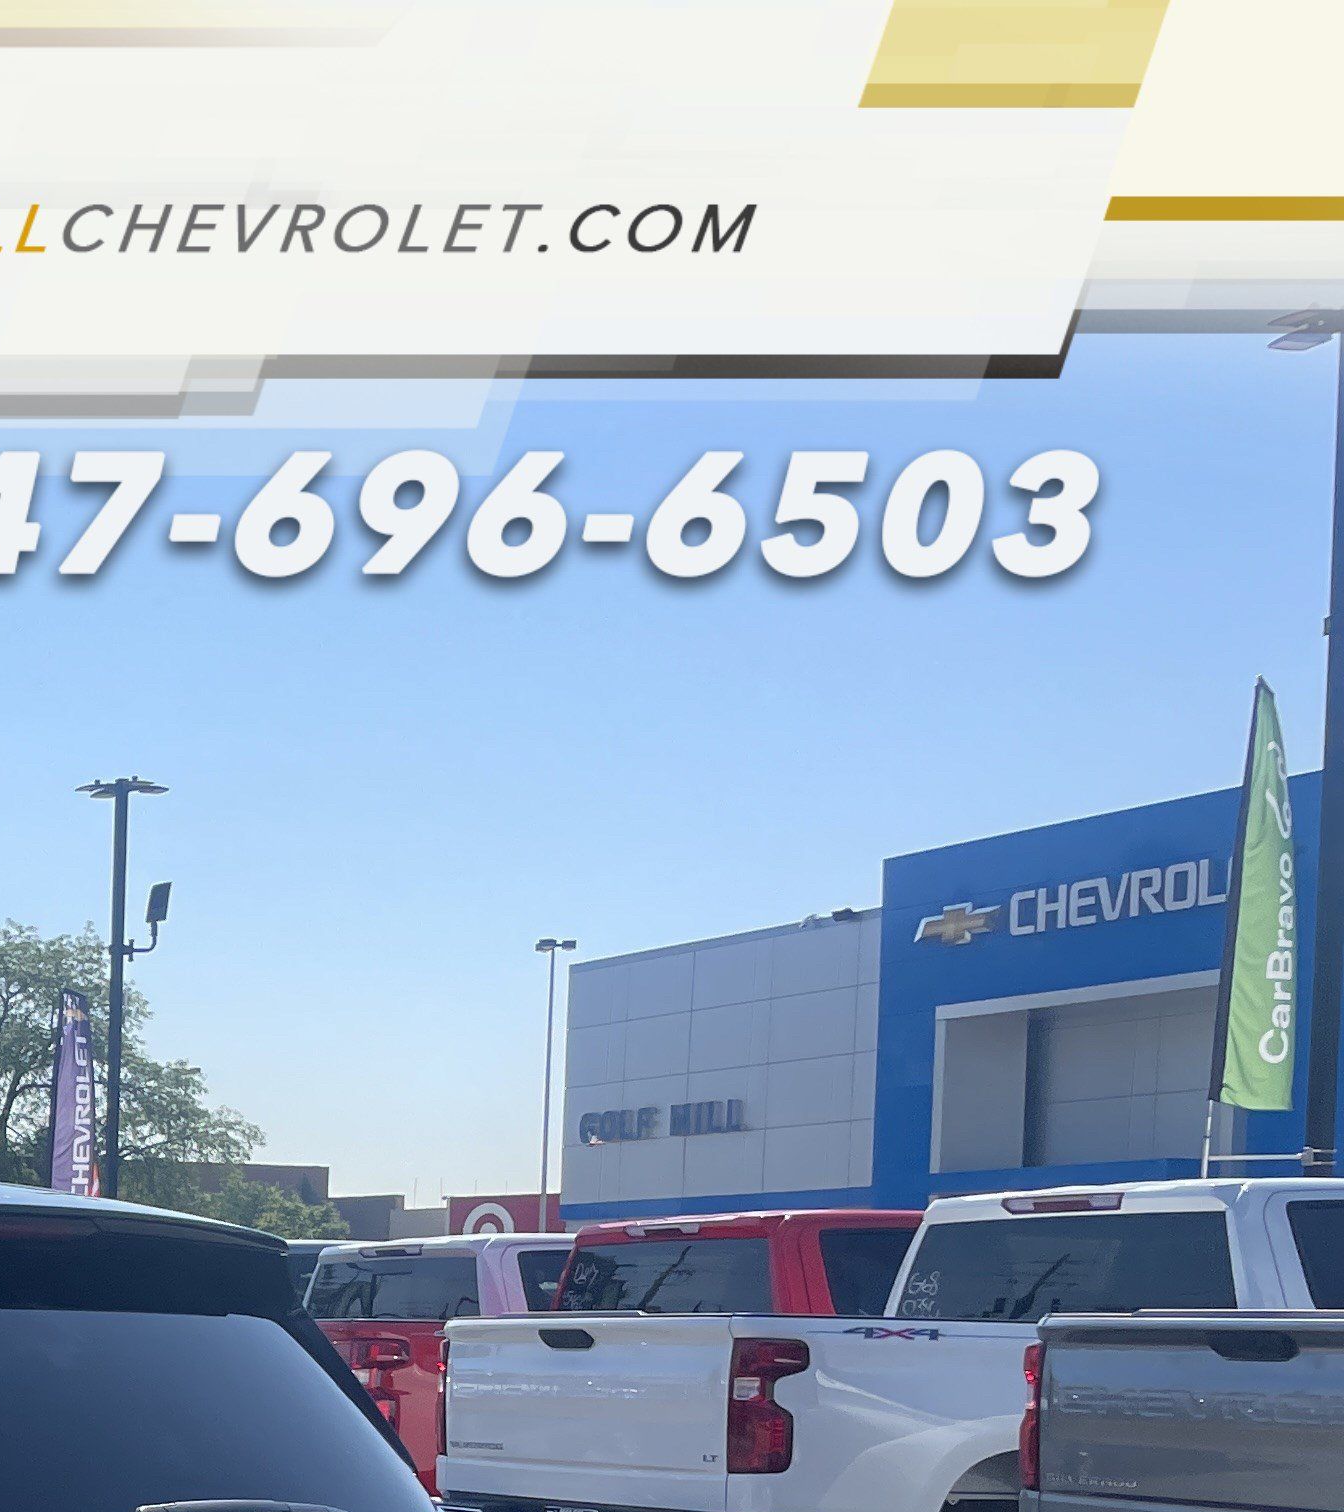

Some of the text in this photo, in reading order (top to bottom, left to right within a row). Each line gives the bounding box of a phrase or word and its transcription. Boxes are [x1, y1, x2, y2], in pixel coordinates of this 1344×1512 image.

[1009, 856, 1233, 937] CHEVROL
[1258, 851, 1295, 1064] CarBravo
[579, 1099, 749, 1144] GOLF MILL
[702, 1454, 718, 1463] LT
